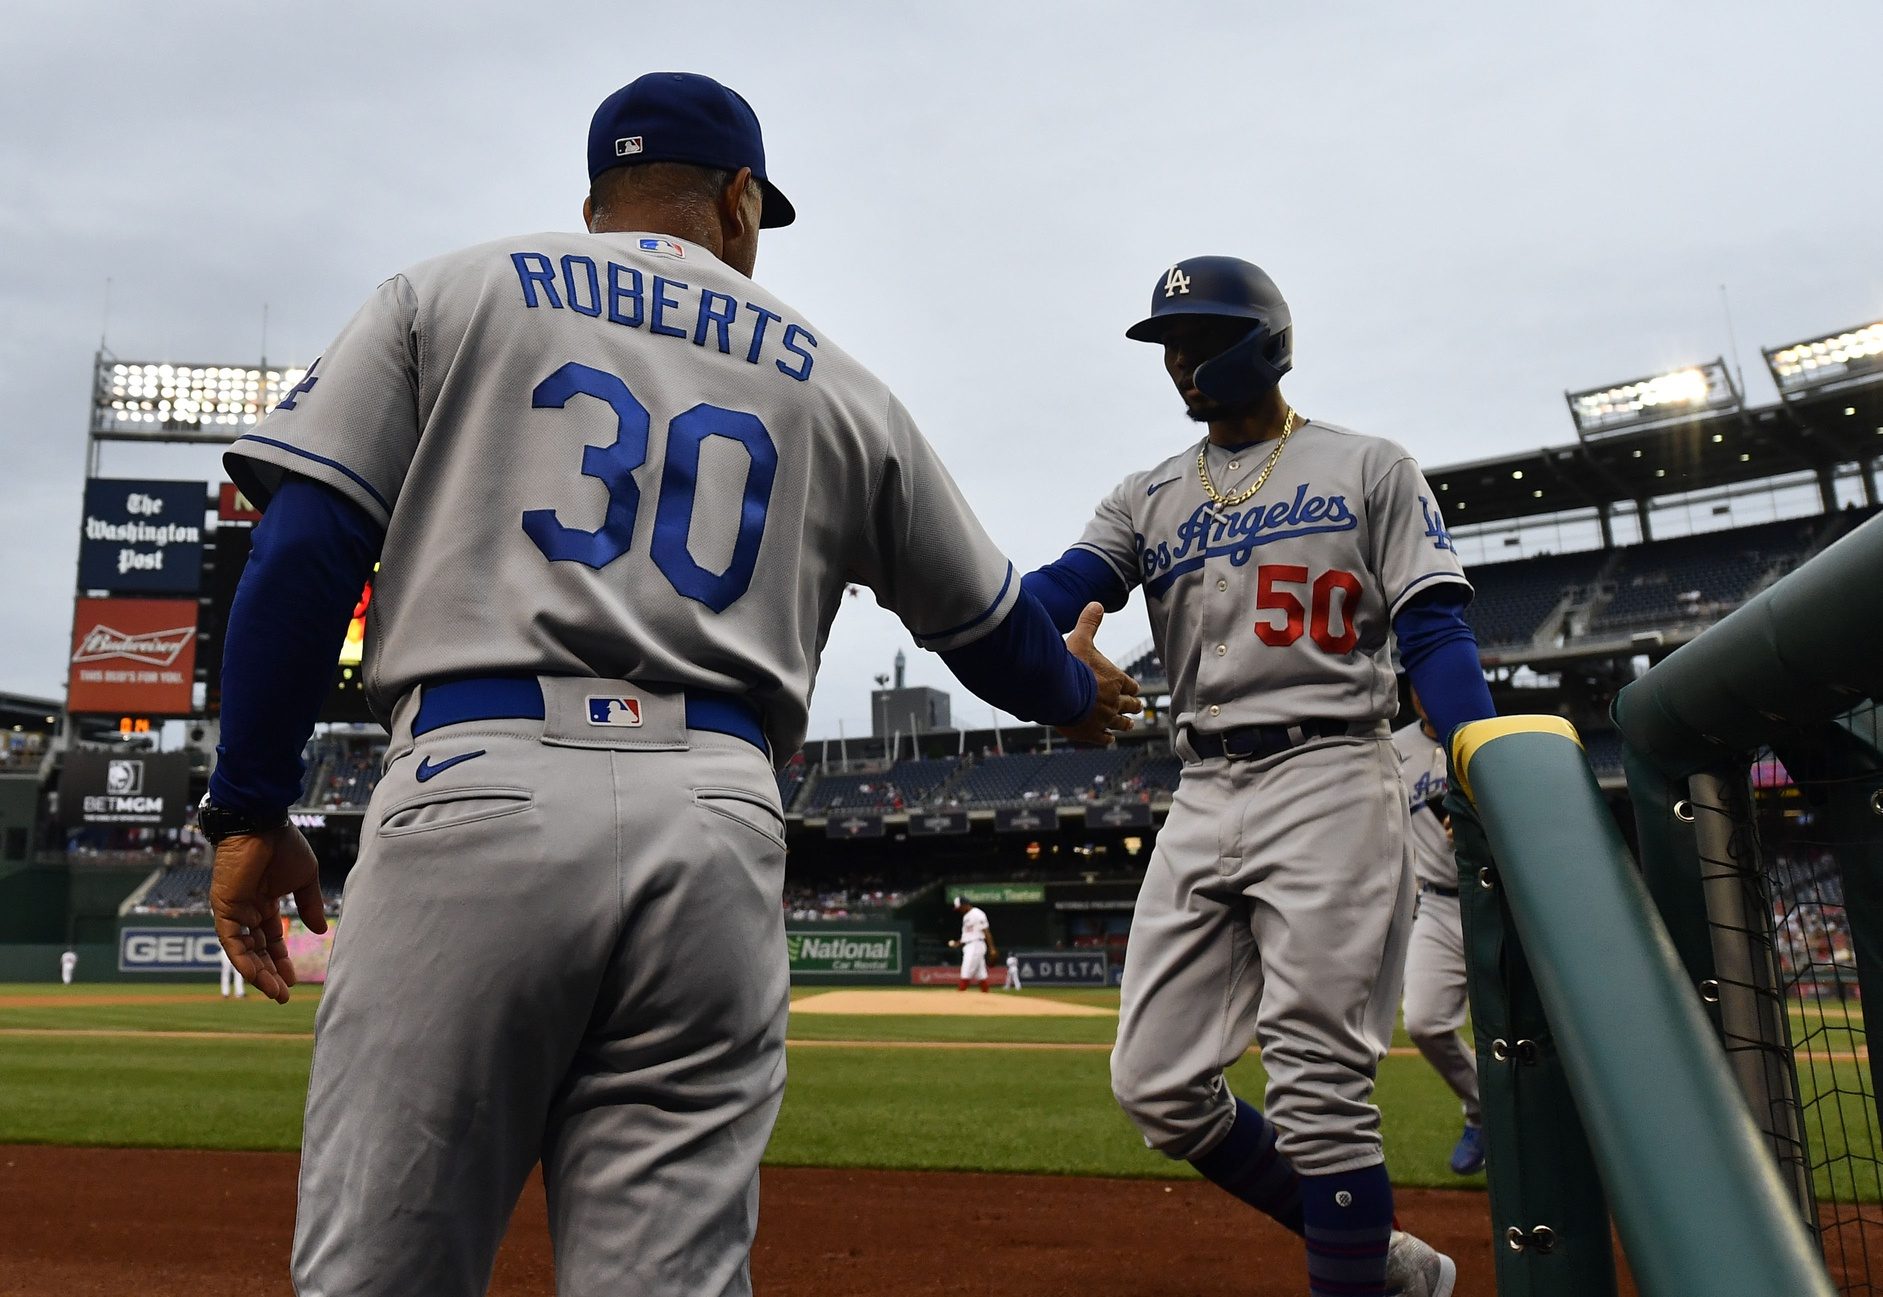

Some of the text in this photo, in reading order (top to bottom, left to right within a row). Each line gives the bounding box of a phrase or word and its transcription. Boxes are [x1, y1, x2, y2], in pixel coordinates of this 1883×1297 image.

[1164, 264, 1191, 298] LA
[510, 252, 818, 382] ROBERTS
[522, 361, 779, 614] 30
[126, 493, 163, 517] The
[86, 516, 200, 547] Washington
[1173, 483, 1357, 567] Angeles
[117, 548, 163, 575] Post
[1254, 564, 1362, 655] 50
[84, 633, 181, 654] Budweiser
[83, 796, 163, 813] BETMGM
[126, 936, 222, 962] GEIC
[801, 938, 892, 959] National
[1040, 962, 1104, 976] DELTA
